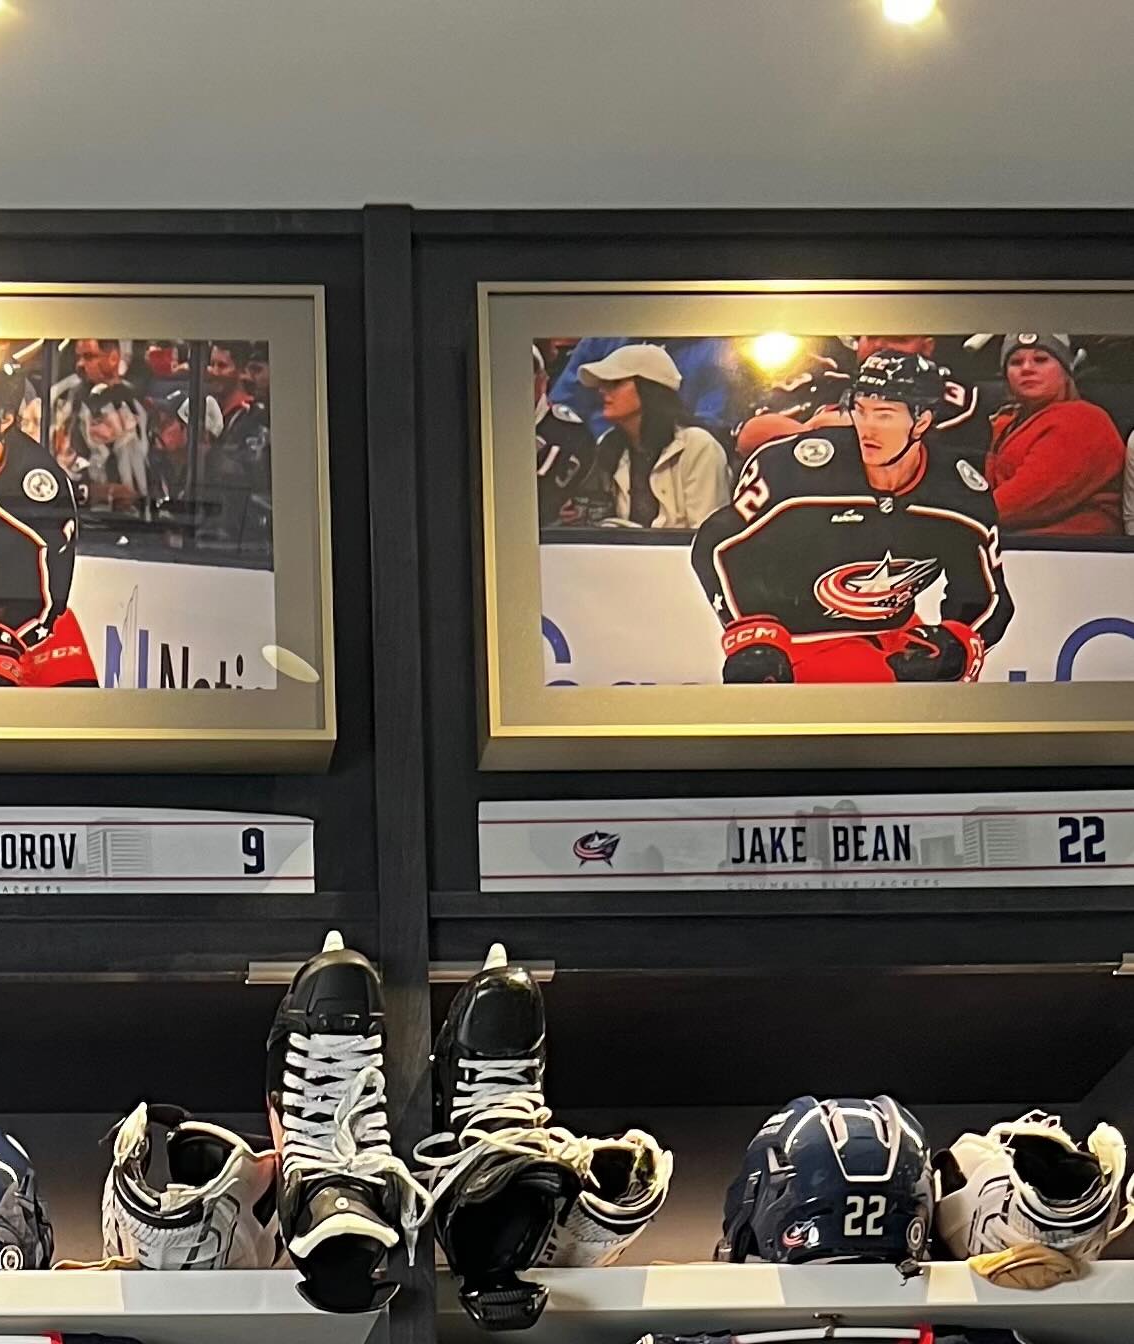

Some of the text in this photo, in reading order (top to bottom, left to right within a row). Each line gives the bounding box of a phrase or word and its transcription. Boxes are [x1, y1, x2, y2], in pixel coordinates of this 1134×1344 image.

[724, 627, 778, 649] CCM
[241, 827, 265, 875] 9
[731, 824, 912, 864] JAKE BEAN
[1058, 815, 1107, 864] 22
[844, 1195, 887, 1237] 22
